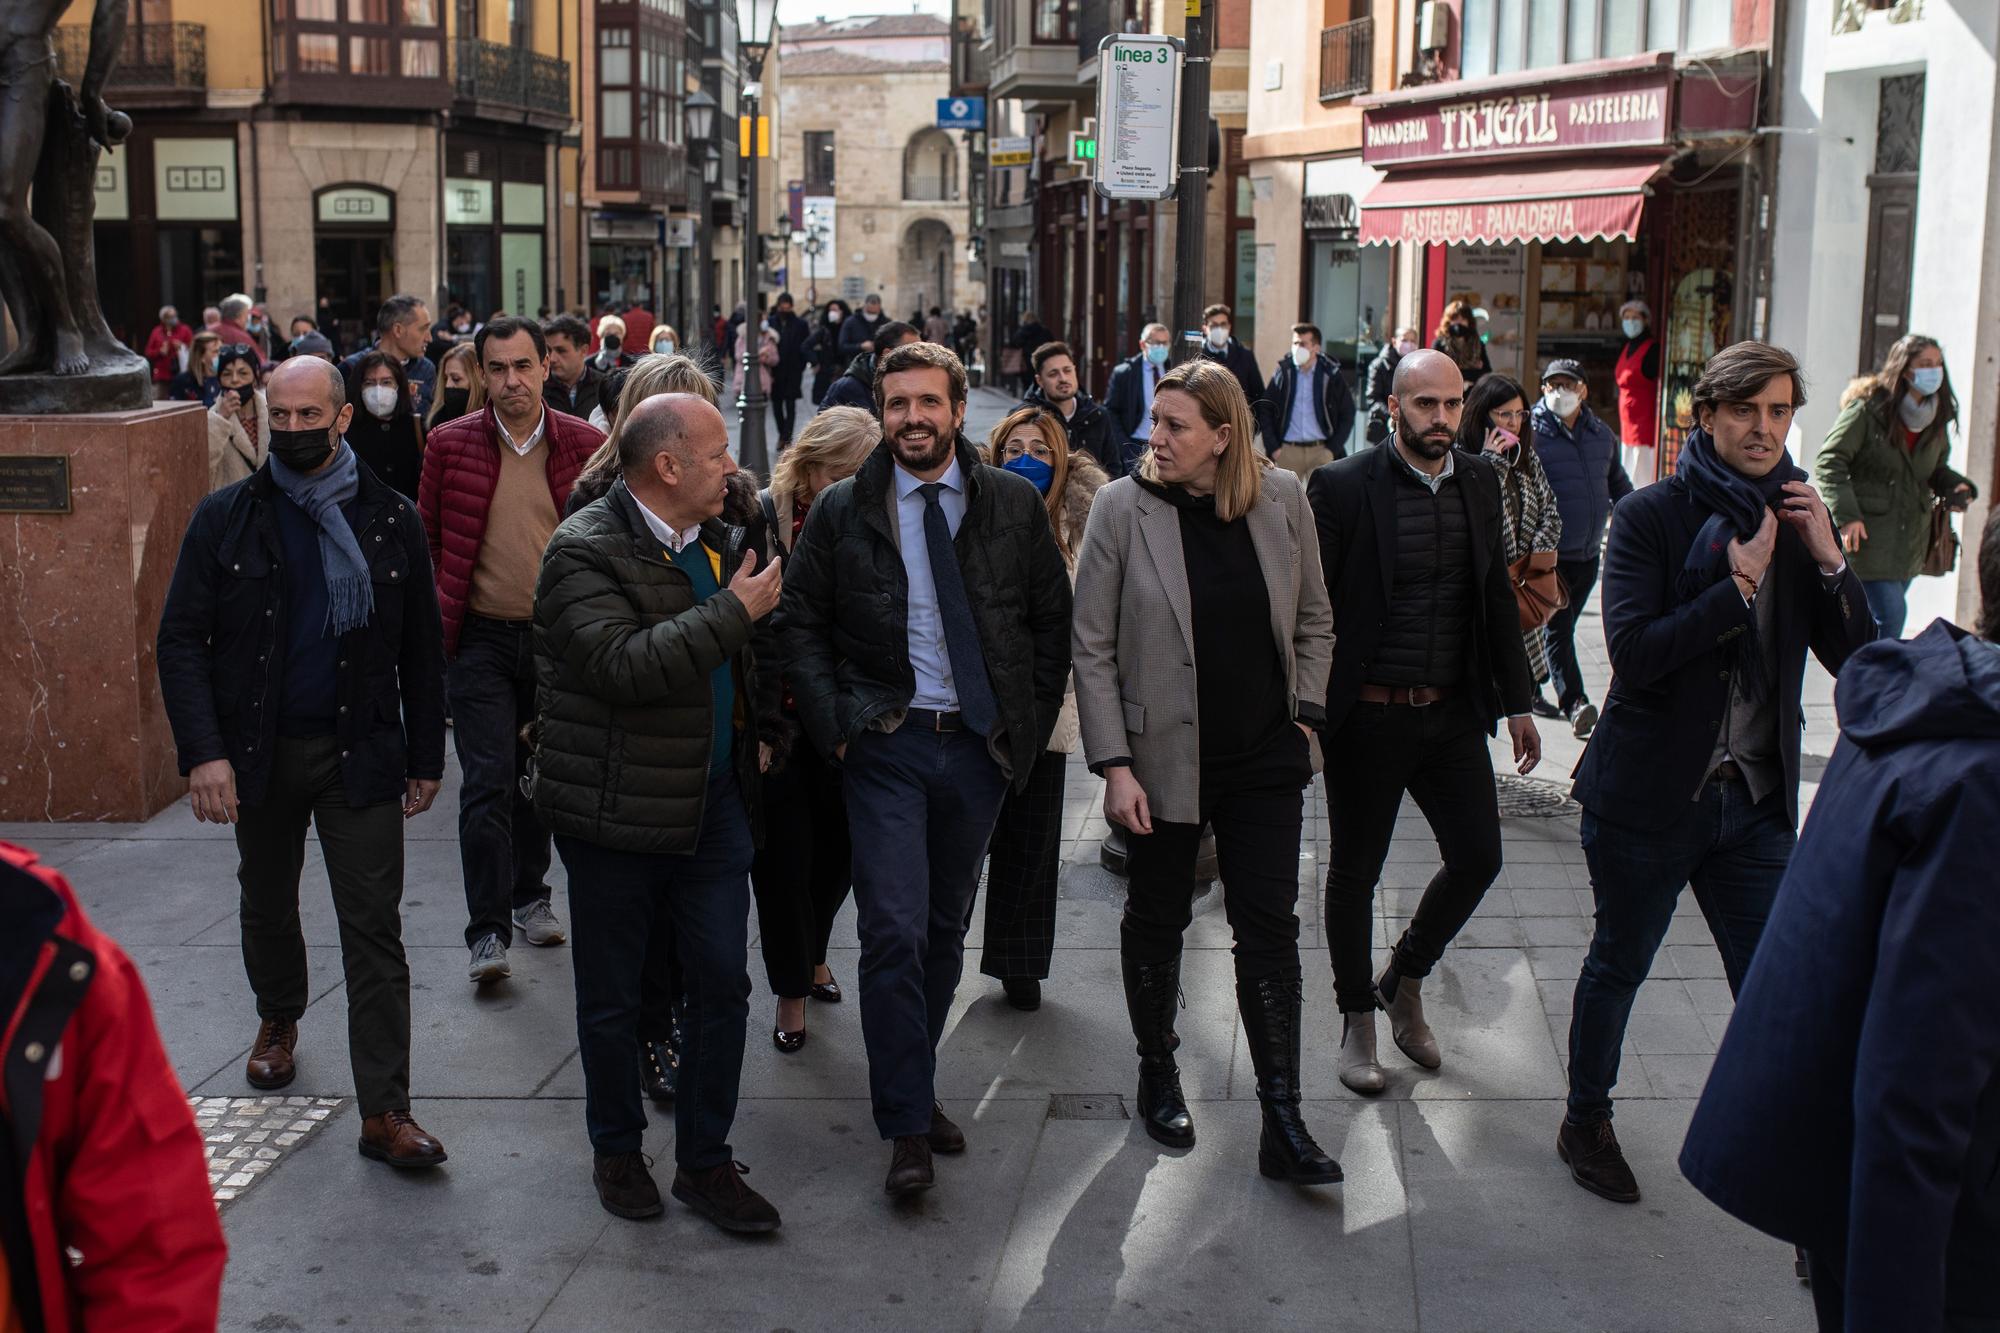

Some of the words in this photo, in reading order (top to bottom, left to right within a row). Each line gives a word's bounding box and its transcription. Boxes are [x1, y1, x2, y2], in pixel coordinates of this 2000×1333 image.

[1114, 45, 1152, 63] línea
[1157, 48, 1168, 64] 3
[1367, 119, 1429, 148] PANADERIA
[1439, 93, 1558, 151] TRIGAL
[1568, 93, 1660, 126] PASTELERIA
[1402, 207, 1473, 237] PASTELERIA
[1486, 202, 1575, 234] PANADERIA
